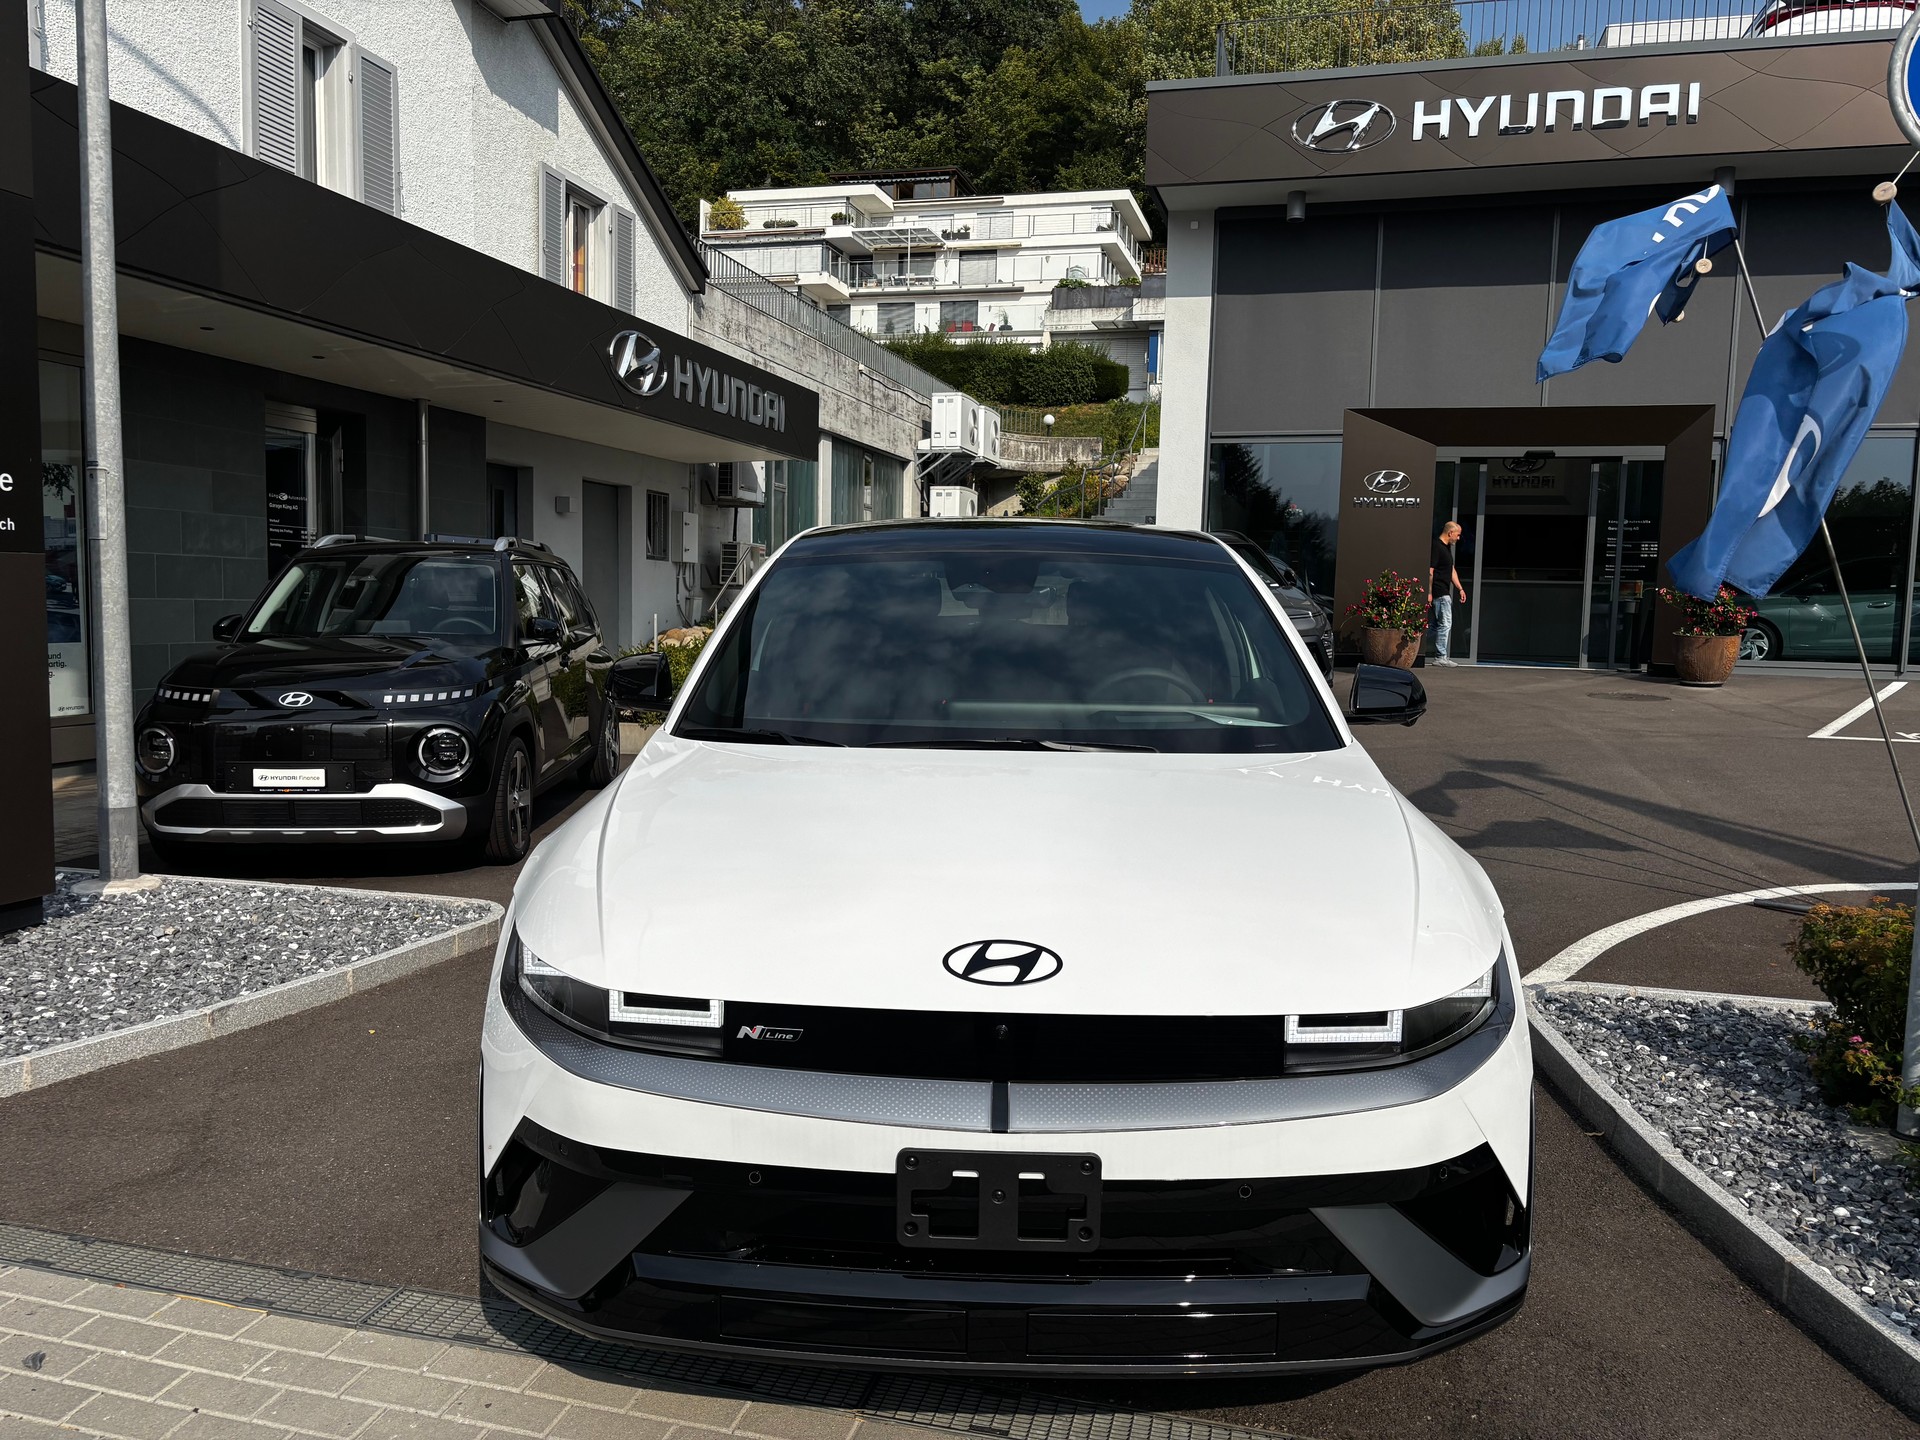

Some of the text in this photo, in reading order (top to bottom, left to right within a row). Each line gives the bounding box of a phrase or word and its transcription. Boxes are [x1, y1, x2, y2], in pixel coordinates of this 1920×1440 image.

[1412, 82, 1700, 141] HYUNDAI
[673, 354, 786, 433] HYUNDAI
[1353, 497, 1420, 508] HYUNDAI
[736, 1025, 794, 1040] N Line
